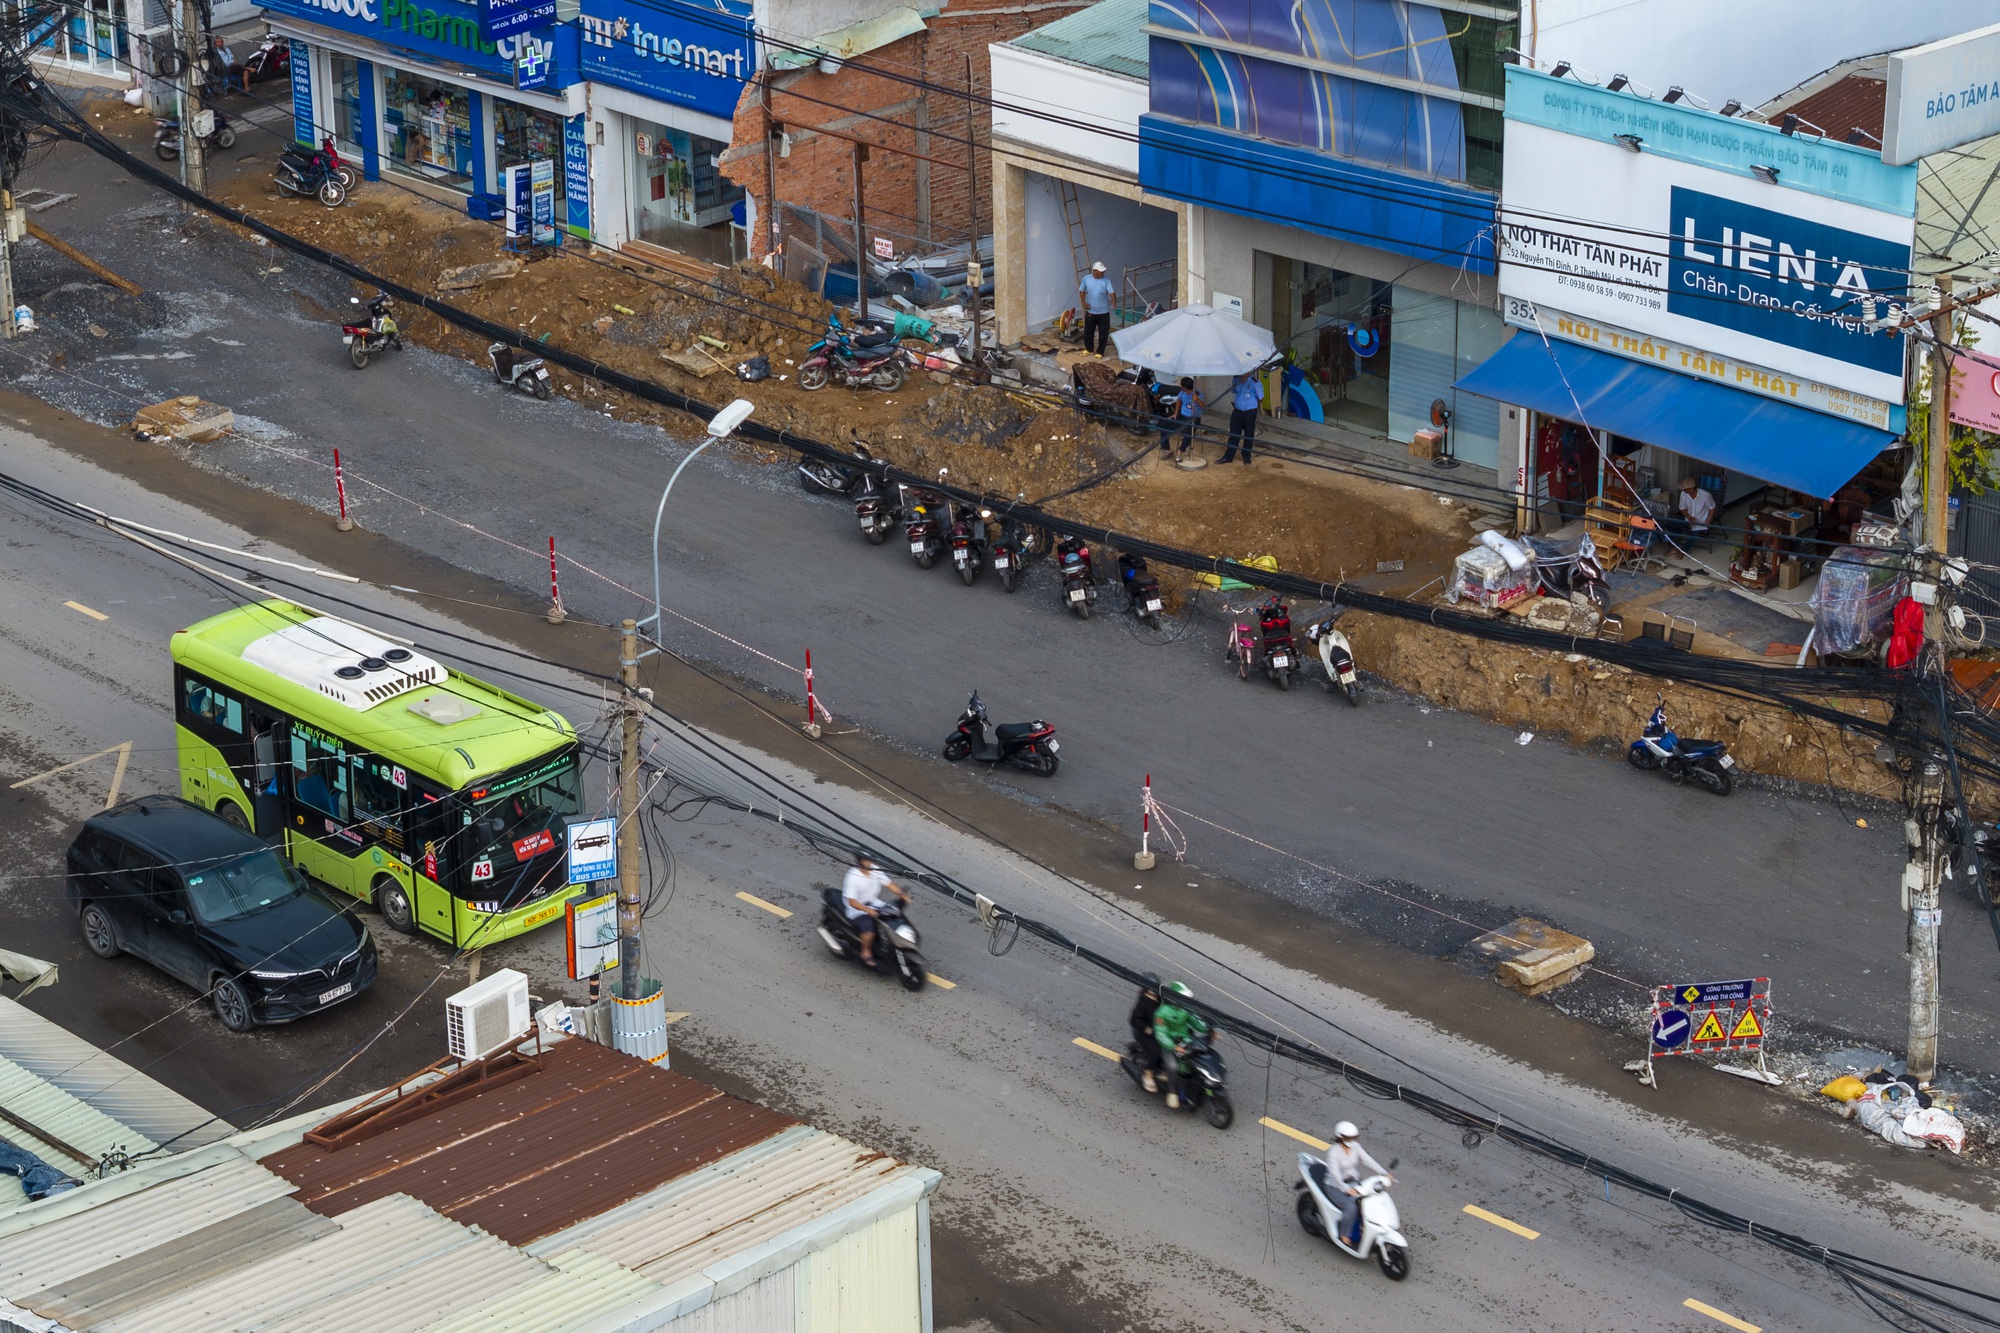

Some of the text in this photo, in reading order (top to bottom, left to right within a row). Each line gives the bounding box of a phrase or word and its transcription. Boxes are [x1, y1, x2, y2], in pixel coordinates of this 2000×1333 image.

[511, 13, 528, 24] 6:00
[579, 14, 614, 48] TH
[293, 58, 308, 67] THEO
[1926, 91, 1956, 119] BẢO
[1960, 83, 1988, 109] TÂM
[1544, 94, 1848, 178] CÔNG TY TRÁCH NHIỆM HỮU HẠN DƯỢC PHẨM BẢO TÂM AN
[566, 143, 586, 159] KẾT
[567, 161, 586, 173] CHẤT
[1508, 225, 1537, 248] NỘI
[1619, 252, 1663, 278] PHÁT
[1558, 275, 1569, 287] ĐT:
[1569, 278, 1586, 291] 0938
[1586, 281, 1595, 293] 60
[1595, 283, 1604, 295] 58
[1605, 285, 1613, 297] 59
[1617, 292, 1634, 304] 0907
[1635, 296, 1647, 306] 733
[1648, 299, 1661, 310] 989
[1510, 300, 1538, 321] 352
[1558, 318, 1599, 342] NỘI
[1609, 333, 1670, 361] THẤT
[1736, 366, 1800, 398] PHÁT
[1828, 388, 1850, 401] 0938
[1853, 394, 1869, 407] 605
[1871, 400, 1888, 413] 859
[1828, 400, 1886, 426] 0907 733 989
[294, 721, 304, 731] XE
[305, 725, 325, 741] BUÝT
[394, 769, 405, 786] 43
[474, 863, 491, 878] 43
[575, 869, 610, 881] BUS STOP
[1703, 994, 1719, 1002] ĐANG
[1706, 983, 1744, 993] CÔNG TRƯỜNG
